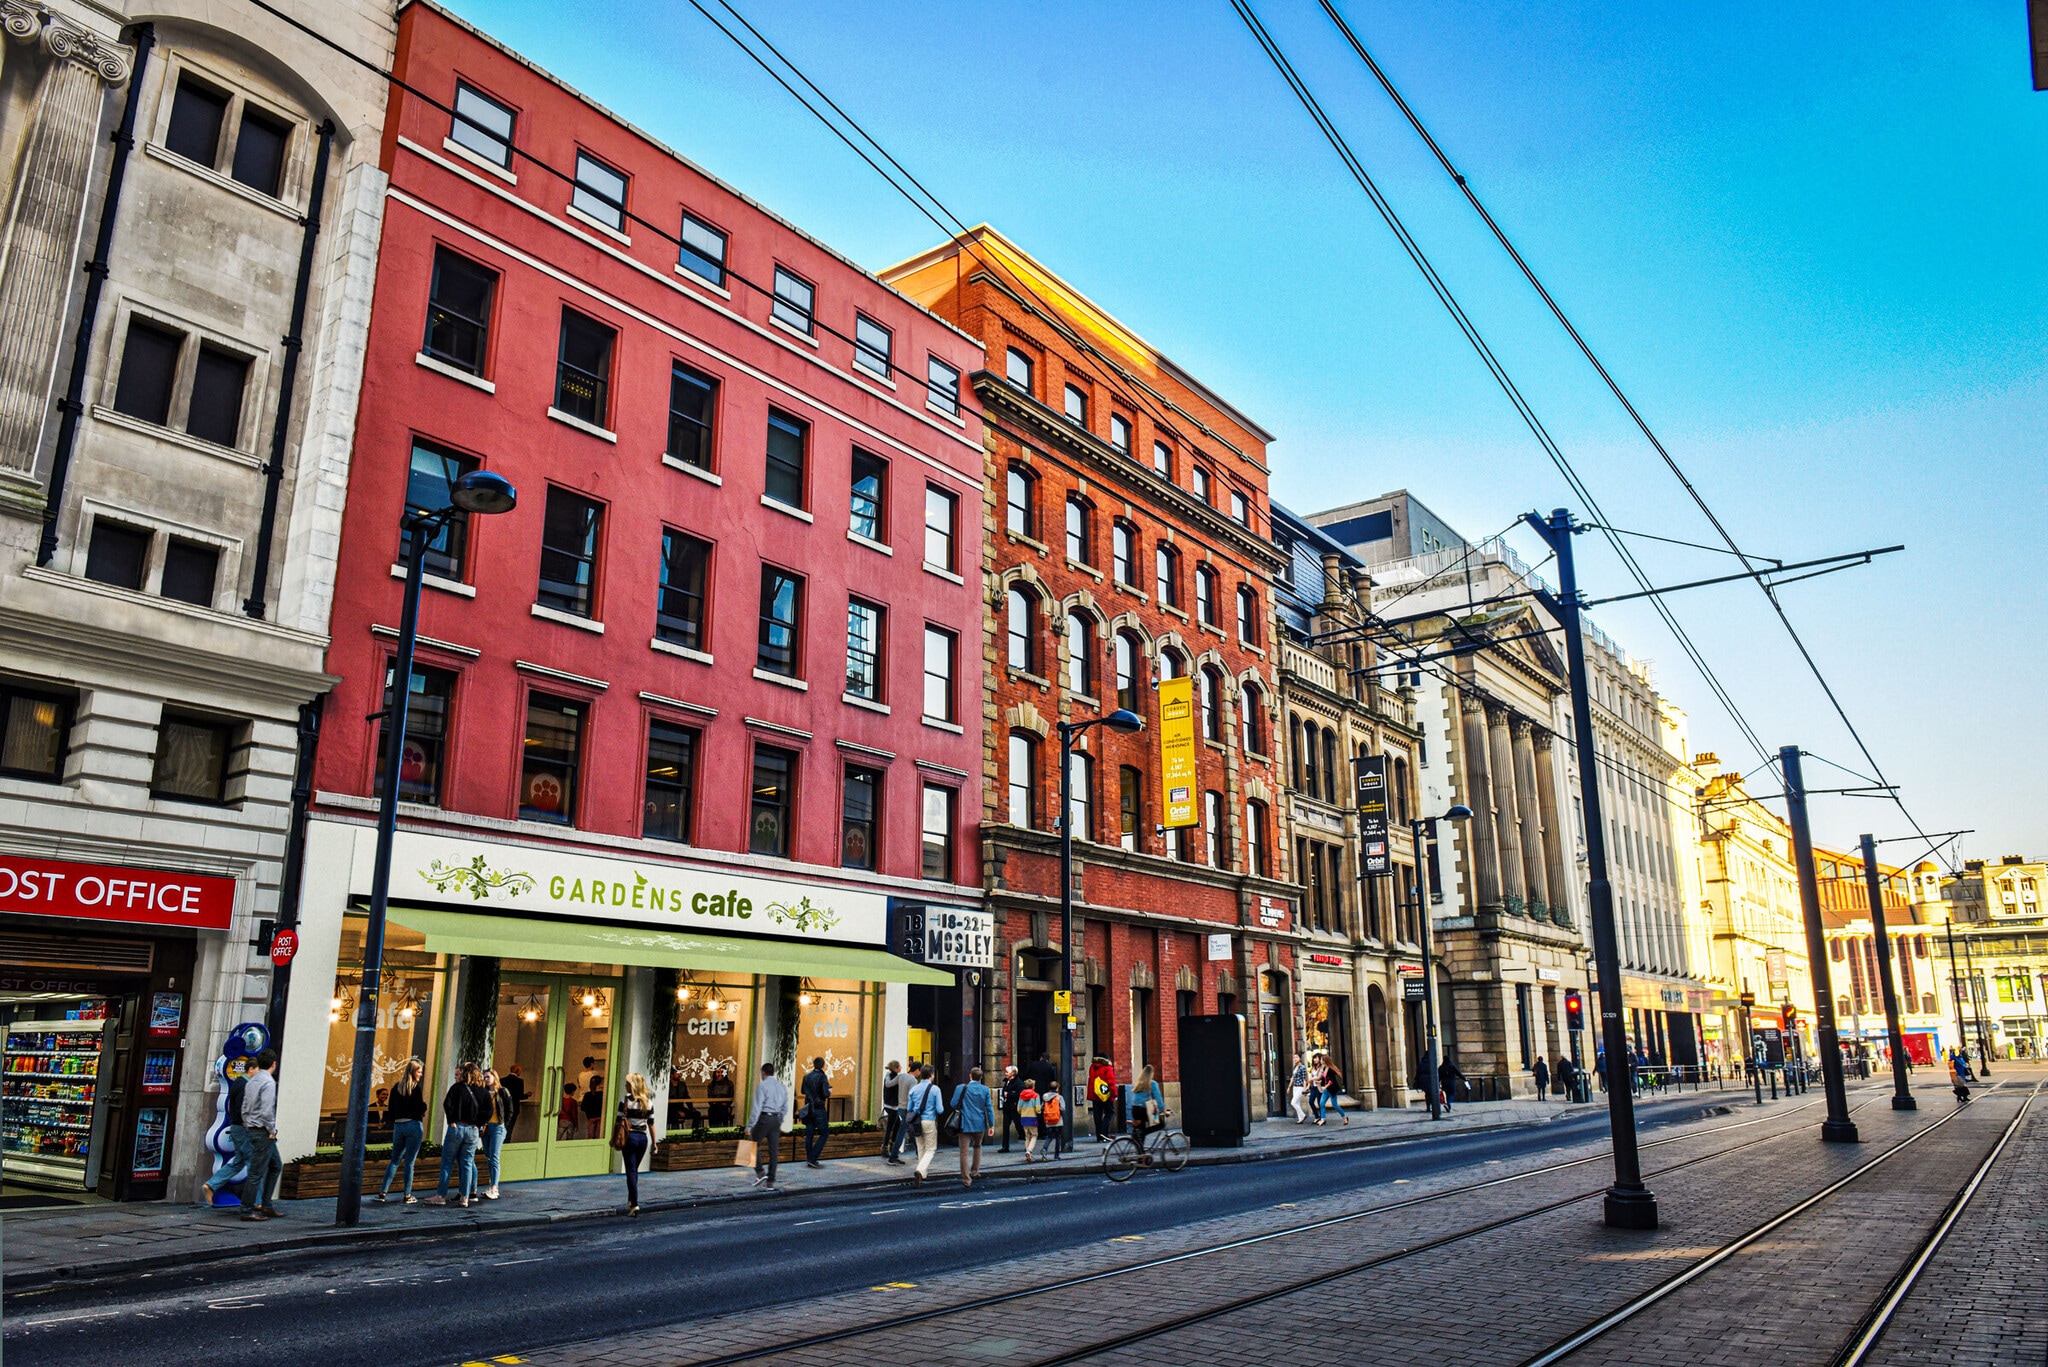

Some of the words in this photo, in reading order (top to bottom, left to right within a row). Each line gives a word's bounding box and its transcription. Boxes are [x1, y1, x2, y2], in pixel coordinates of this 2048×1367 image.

[1170, 805, 1191, 816] Orbit
[75, 876, 202, 914] OFFICE
[549, 875, 682, 913] GARDENS
[691, 889, 753, 919] cafe
[1260, 896, 1272, 907] THE
[905, 914, 923, 931] 18
[941, 913, 979, 932] 18-22
[278, 936, 293, 946] POST
[903, 937, 924, 956] 22
[928, 929, 991, 960] MOSLEY
[273, 946, 292, 957] OFFICE
[30, 980, 97, 993] OFFICE
[687, 1014, 729, 1036] cafe
[813, 1017, 848, 1038] cafe
[133, 1171, 159, 1179] Souvenirs
